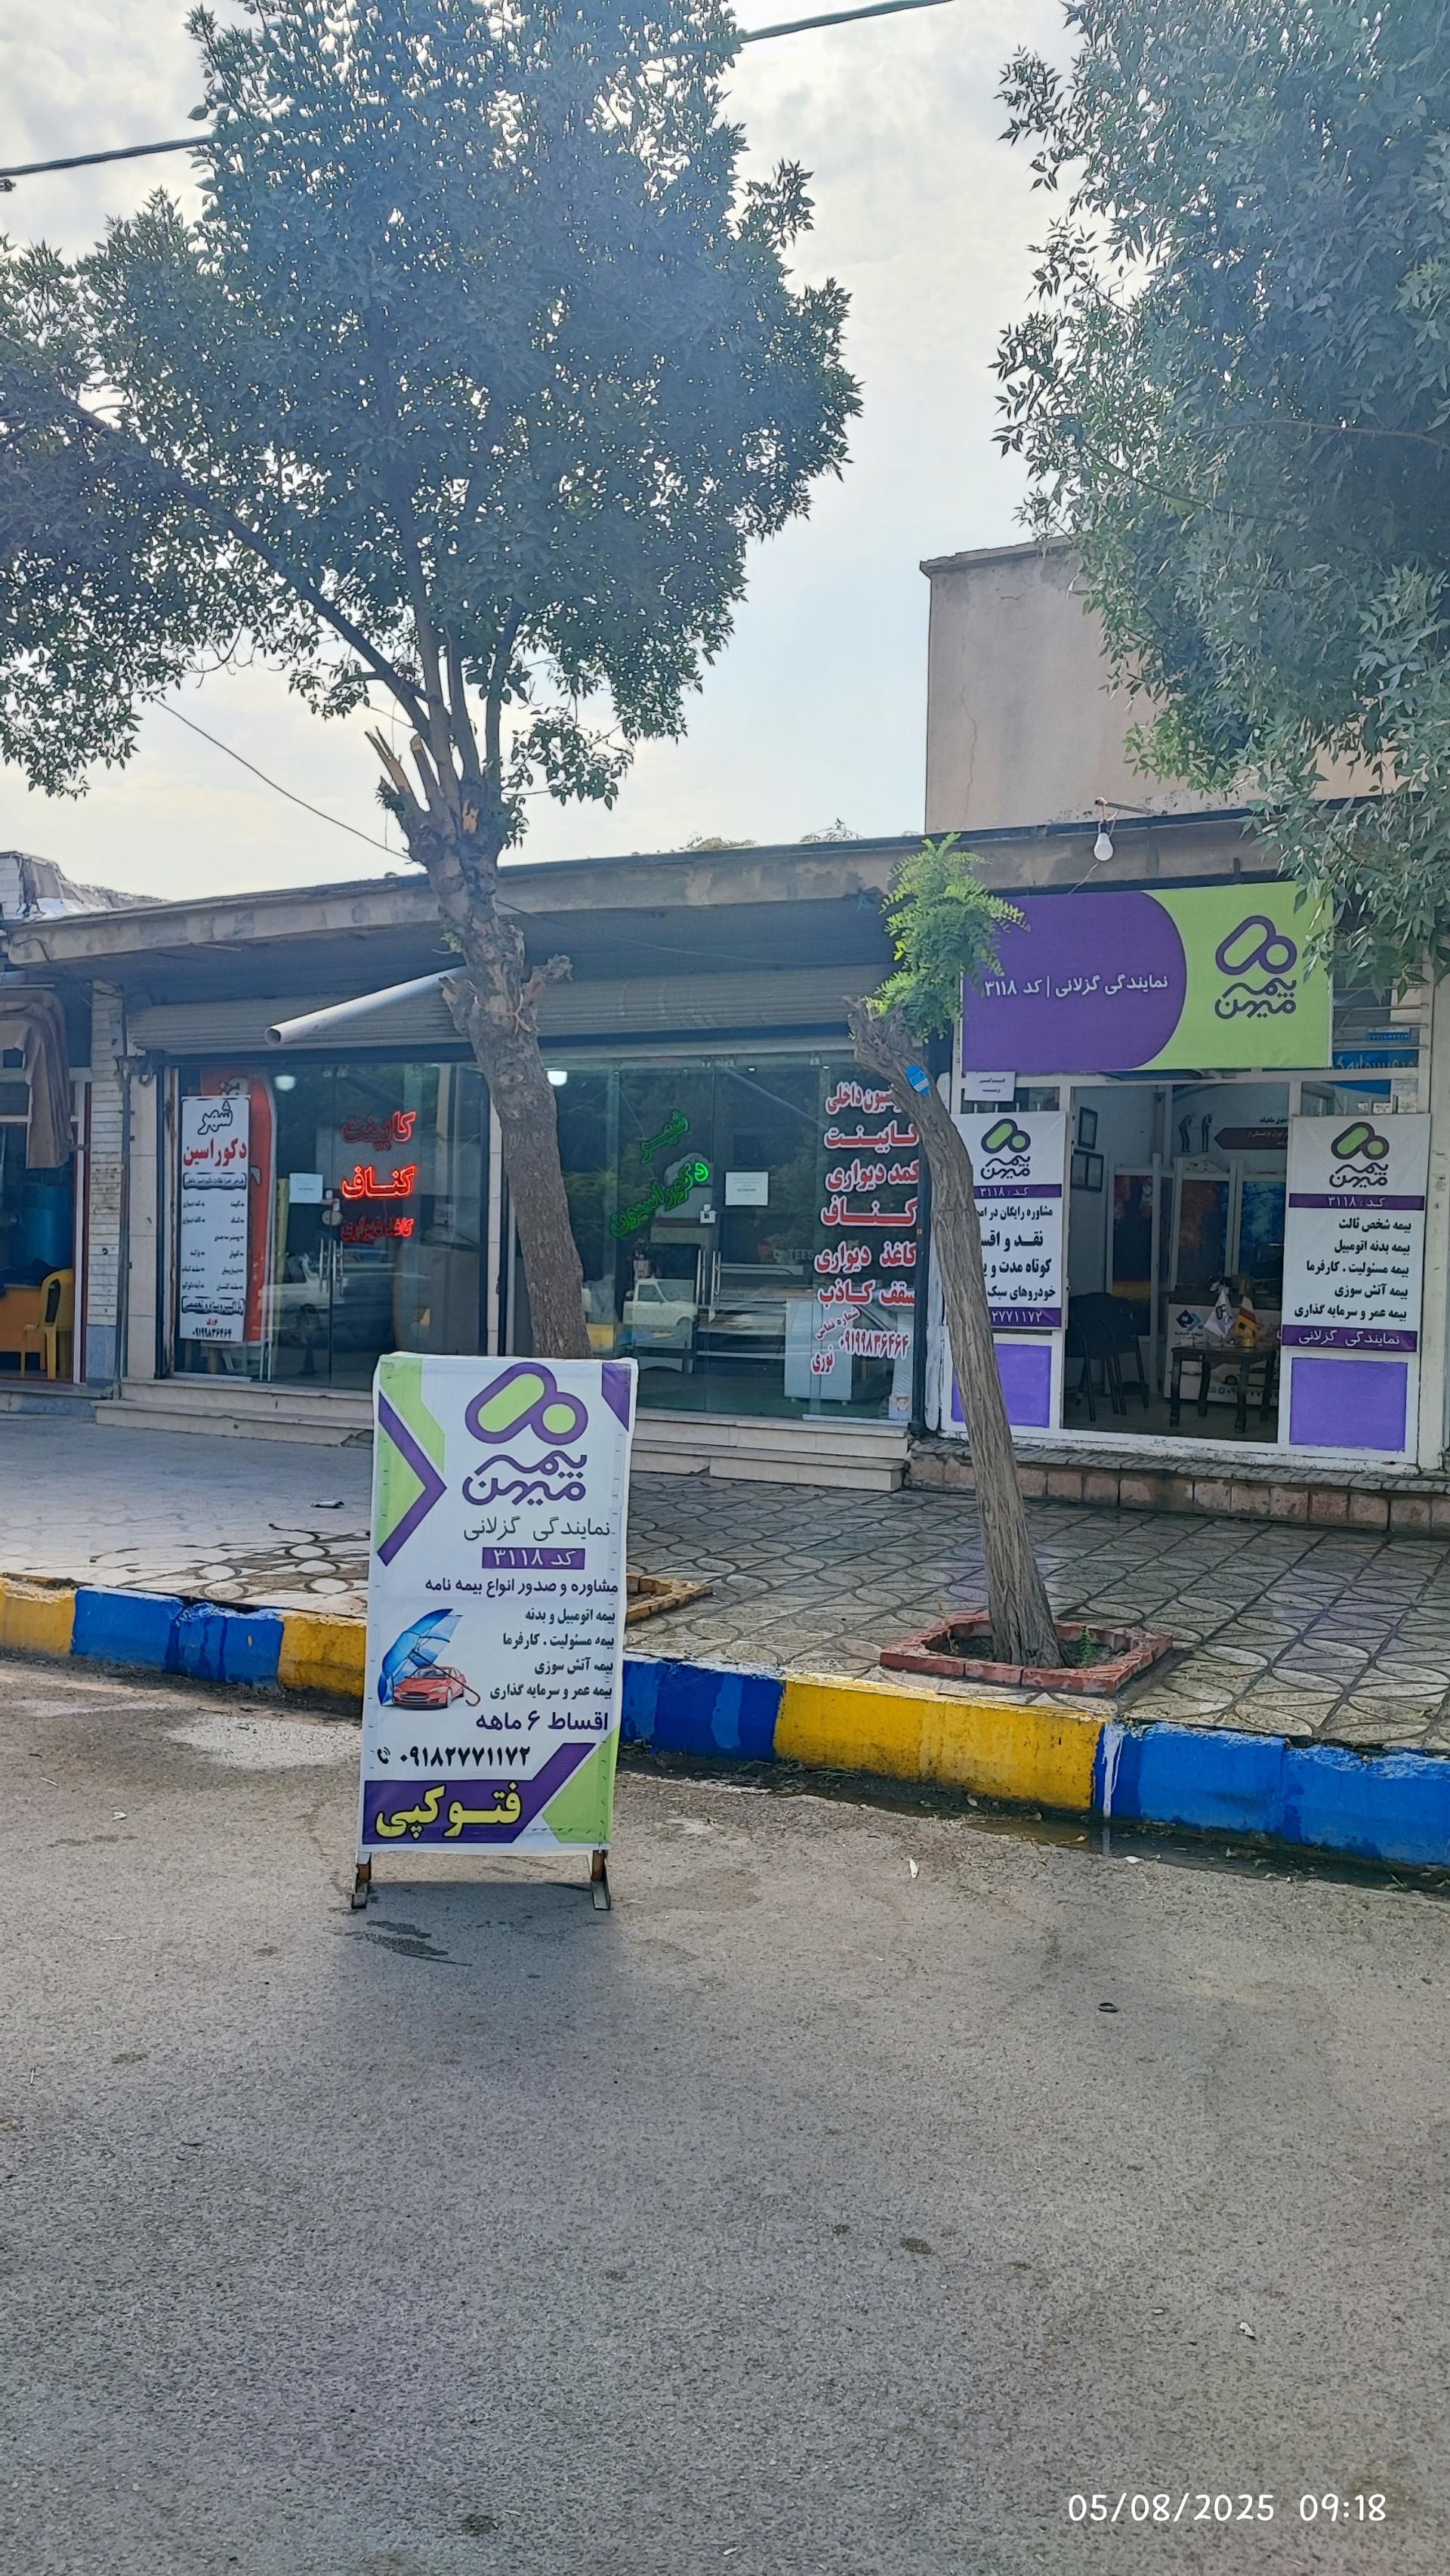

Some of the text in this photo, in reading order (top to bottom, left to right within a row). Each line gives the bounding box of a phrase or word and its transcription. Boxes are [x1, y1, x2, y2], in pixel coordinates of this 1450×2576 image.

[985, 974, 1168, 997] نمایندگی گزلانی کد ۳۱۱۸
[1222, 978, 1297, 998] بیمه
[1214, 999, 1296, 1019] میهن
[825, 1082, 863, 1115] داخلی
[197, 1100, 233, 1135] شهر
[342, 1110, 417, 1151] کابینت
[641, 1110, 689, 1163] شهر
[986, 1155, 1031, 1168] بیمه
[1334, 1162, 1389, 1175] بیمه
[341, 1165, 417, 1199] کناف
[825, 1158, 887, 1191] دیواری
[980, 1168, 1030, 1179] میهن
[1329, 1174, 1388, 1188] میهن
[611, 1162, 709, 1237] دکوراسیون
[1328, 1196, 1356, 1206] ۳۱۱۸
[821, 1194, 918, 1227] کناف
[989, 1208, 998, 1220] در
[1000, 1206, 1025, 1220] رایگان
[1026, 1205, 1053, 1220] مشاوره
[1339, 1217, 1411, 1234] بیمه شخص ثالث
[981, 1230, 1044, 1252] نقد و اقس
[1334, 1239, 1410, 1256] بیمه بدنه اتومبیل
[814, 1240, 916, 1273] کاغذ دیواری
[991, 1265, 996, 1277] و
[999, 1262, 1023, 1273] مدت
[1026, 1258, 1052, 1277] کوتاه
[1307, 1259, 1409, 1277] بیمه مسئولیت کارفرما
[818, 1278, 915, 1309] سقف کاذب
[987, 1285, 1056, 1301] خودروهای سبک
[1334, 1283, 1408, 1299] بیمه آتش سوزی
[990, 1311, 1042, 1322] ۲۷۷۱۱۷۲
[1294, 1304, 1407, 1321] بیمه عمر و سرمایه گذاری
[816, 1305, 860, 1341] شماره تماس
[1299, 1330, 1400, 1346] نمایندگی گزلانی
[810, 1345, 835, 1375] نوری
[474, 1450, 587, 1478] بیمه
[462, 1476, 586, 1506] میهن
[464, 1515, 610, 1541] نمایندگی گزلانی
[493, 1549, 576, 1566] کد ۳۱۱۸
[425, 1577, 618, 1598] مشاوره و صدور انواع بیمه نامه
[526, 1608, 615, 1625] بیمه اتومبیل و بدنه
[503, 1632, 614, 1650] بیمه مسئولیت کارفرما
[535, 1657, 613, 1675] بیمه آتش سوزی
[490, 1683, 612, 1700] بیمه عمر و سرمایه گذاری
[476, 1710, 609, 1731] اقساط ۶ ماهه
[400, 1746, 530, 1767] ۰۹۱۸۲۷۷۱۱۷۲
